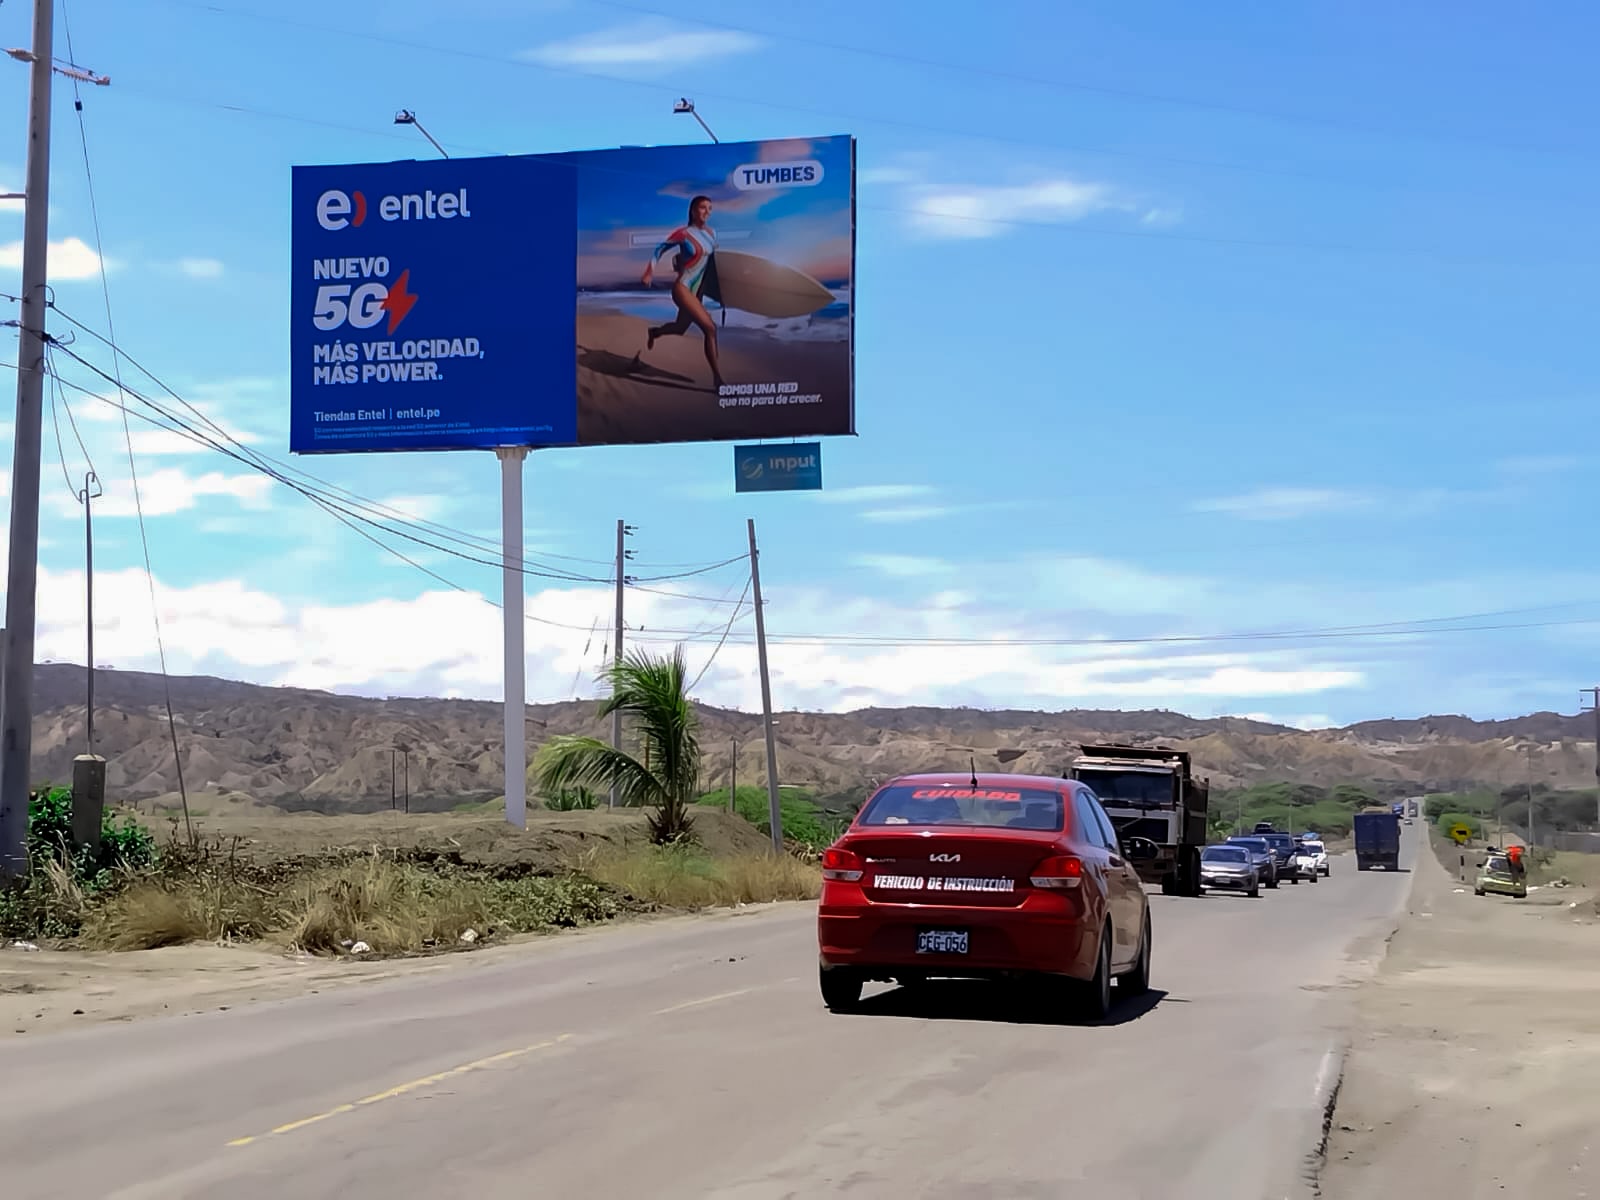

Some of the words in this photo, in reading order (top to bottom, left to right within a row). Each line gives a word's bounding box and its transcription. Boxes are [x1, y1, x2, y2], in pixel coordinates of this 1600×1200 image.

[742, 166, 815, 185] TUMBES
[379, 188, 471, 221] entel
[313, 256, 390, 280] NUEVO
[312, 282, 389, 331] 5G
[313, 339, 359, 364] MÁS
[362, 337, 485, 361] VELOCIDAD,
[313, 361, 359, 386] MÁS
[362, 361, 444, 384] POWER.
[719, 384, 753, 396] SOMOS
[754, 383, 776, 394] UNA
[778, 382, 798, 393] RED
[719, 397, 737, 408] que
[738, 397, 751, 406] no
[752, 396, 774, 407] para
[776, 394, 788, 405] de
[789, 394, 823, 404] crecer.
[314, 411, 356, 422] Tiendas
[358, 409, 386, 420] Entel
[396, 407, 441, 420] entel.pe
[769, 454, 817, 472] input
[927, 876, 942, 890] DE
[943, 875, 1015, 892] INSTRUCCIÓN
